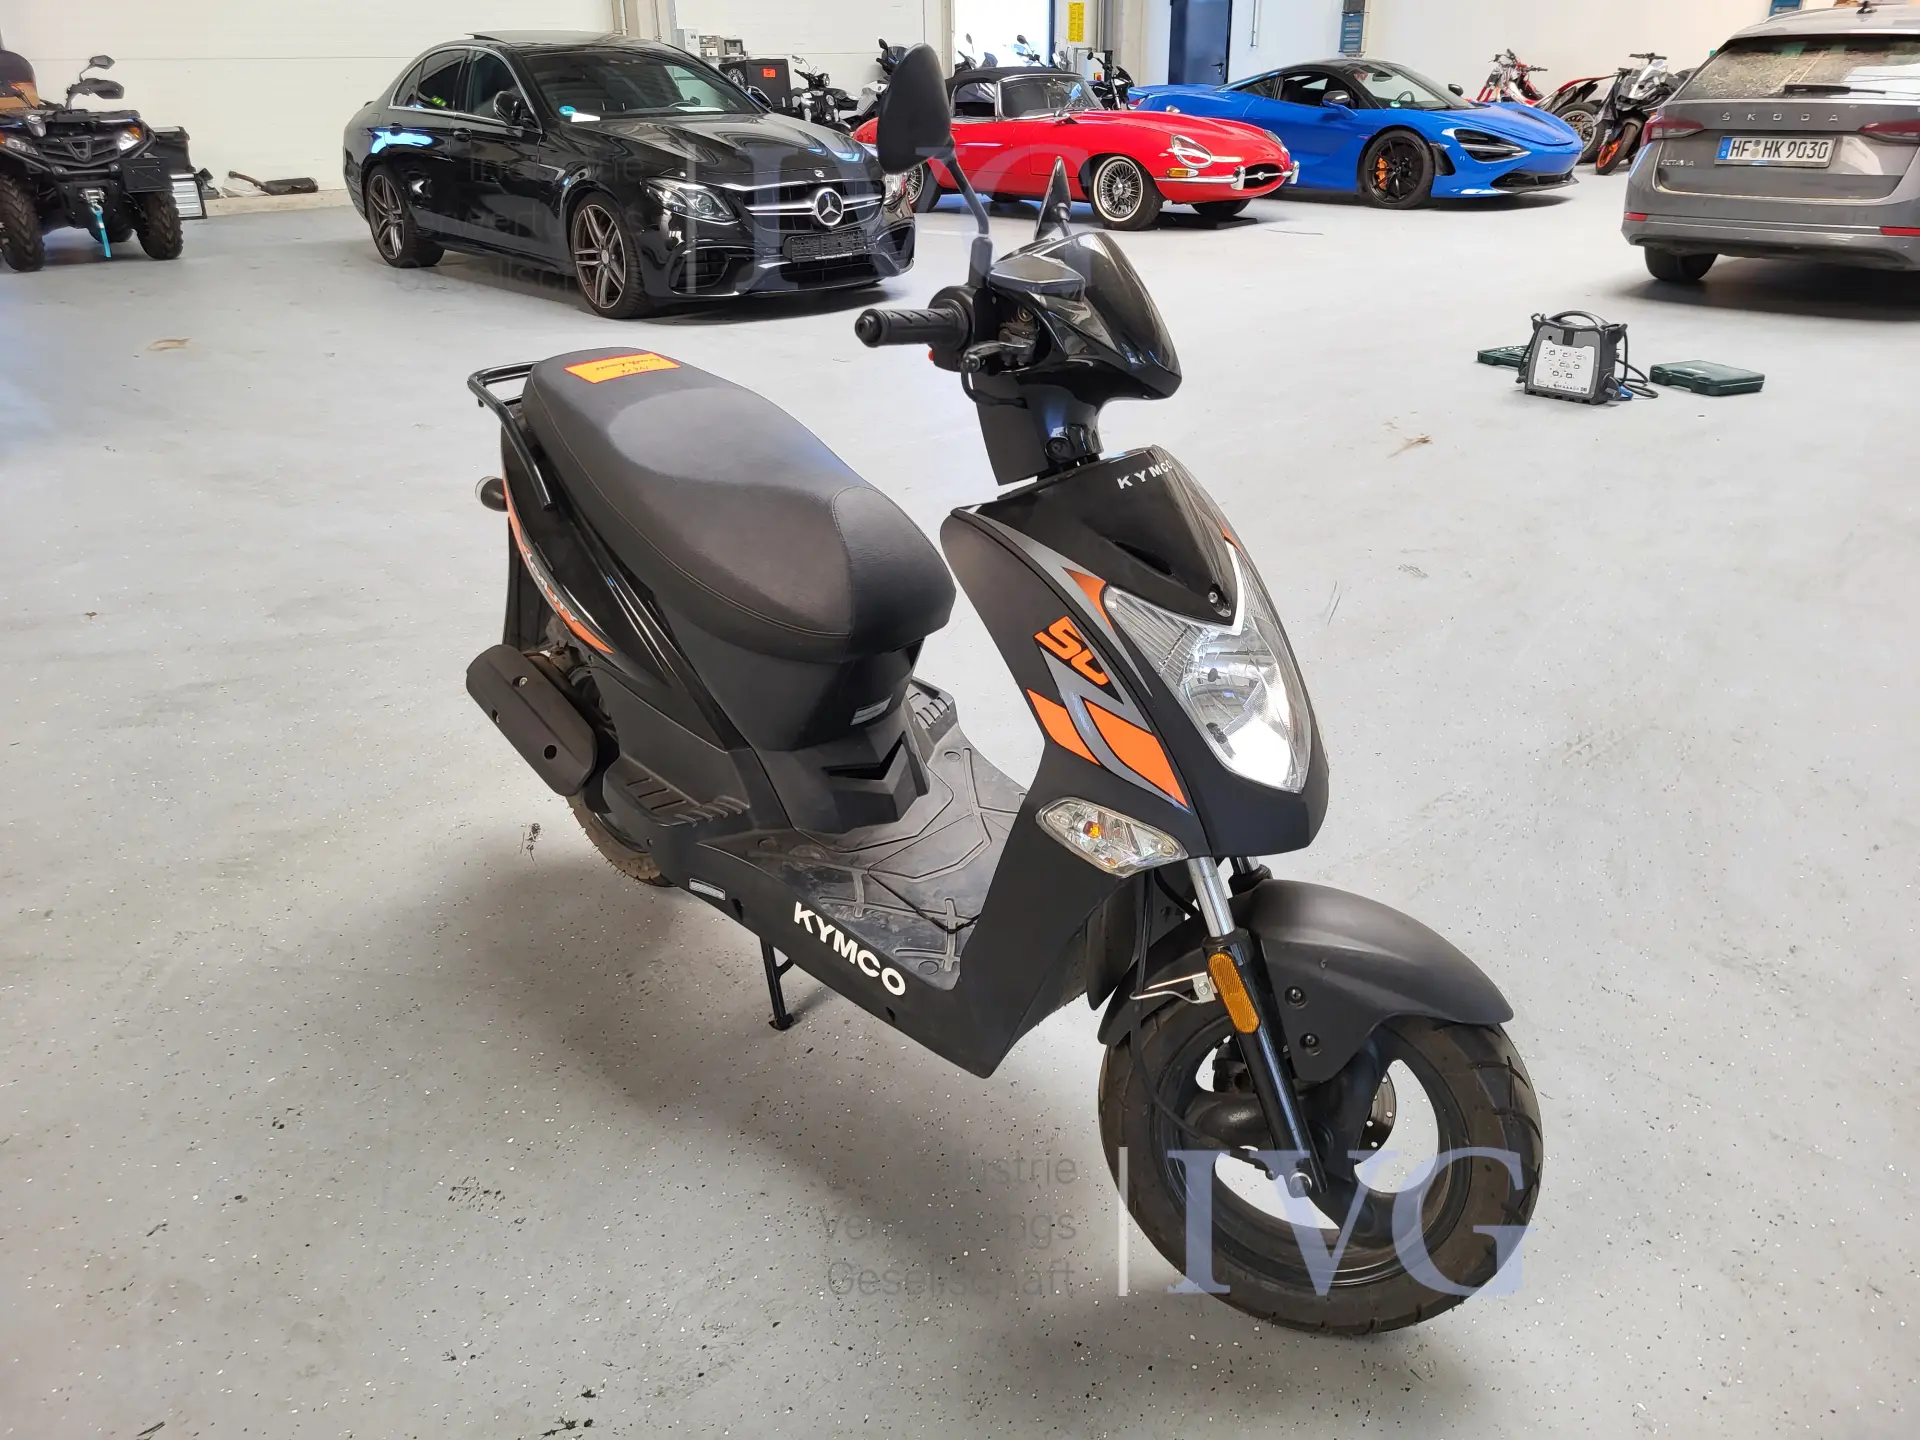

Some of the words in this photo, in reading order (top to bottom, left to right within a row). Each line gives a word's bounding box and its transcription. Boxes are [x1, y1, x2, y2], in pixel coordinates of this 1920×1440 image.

[1730, 140, 1752, 157] HF
[1761, 140, 1785, 159] HK
[1786, 141, 1829, 159] 9030
[1117, 459, 1173, 490] KYMCO
[793, 901, 906, 996] KYMCO
